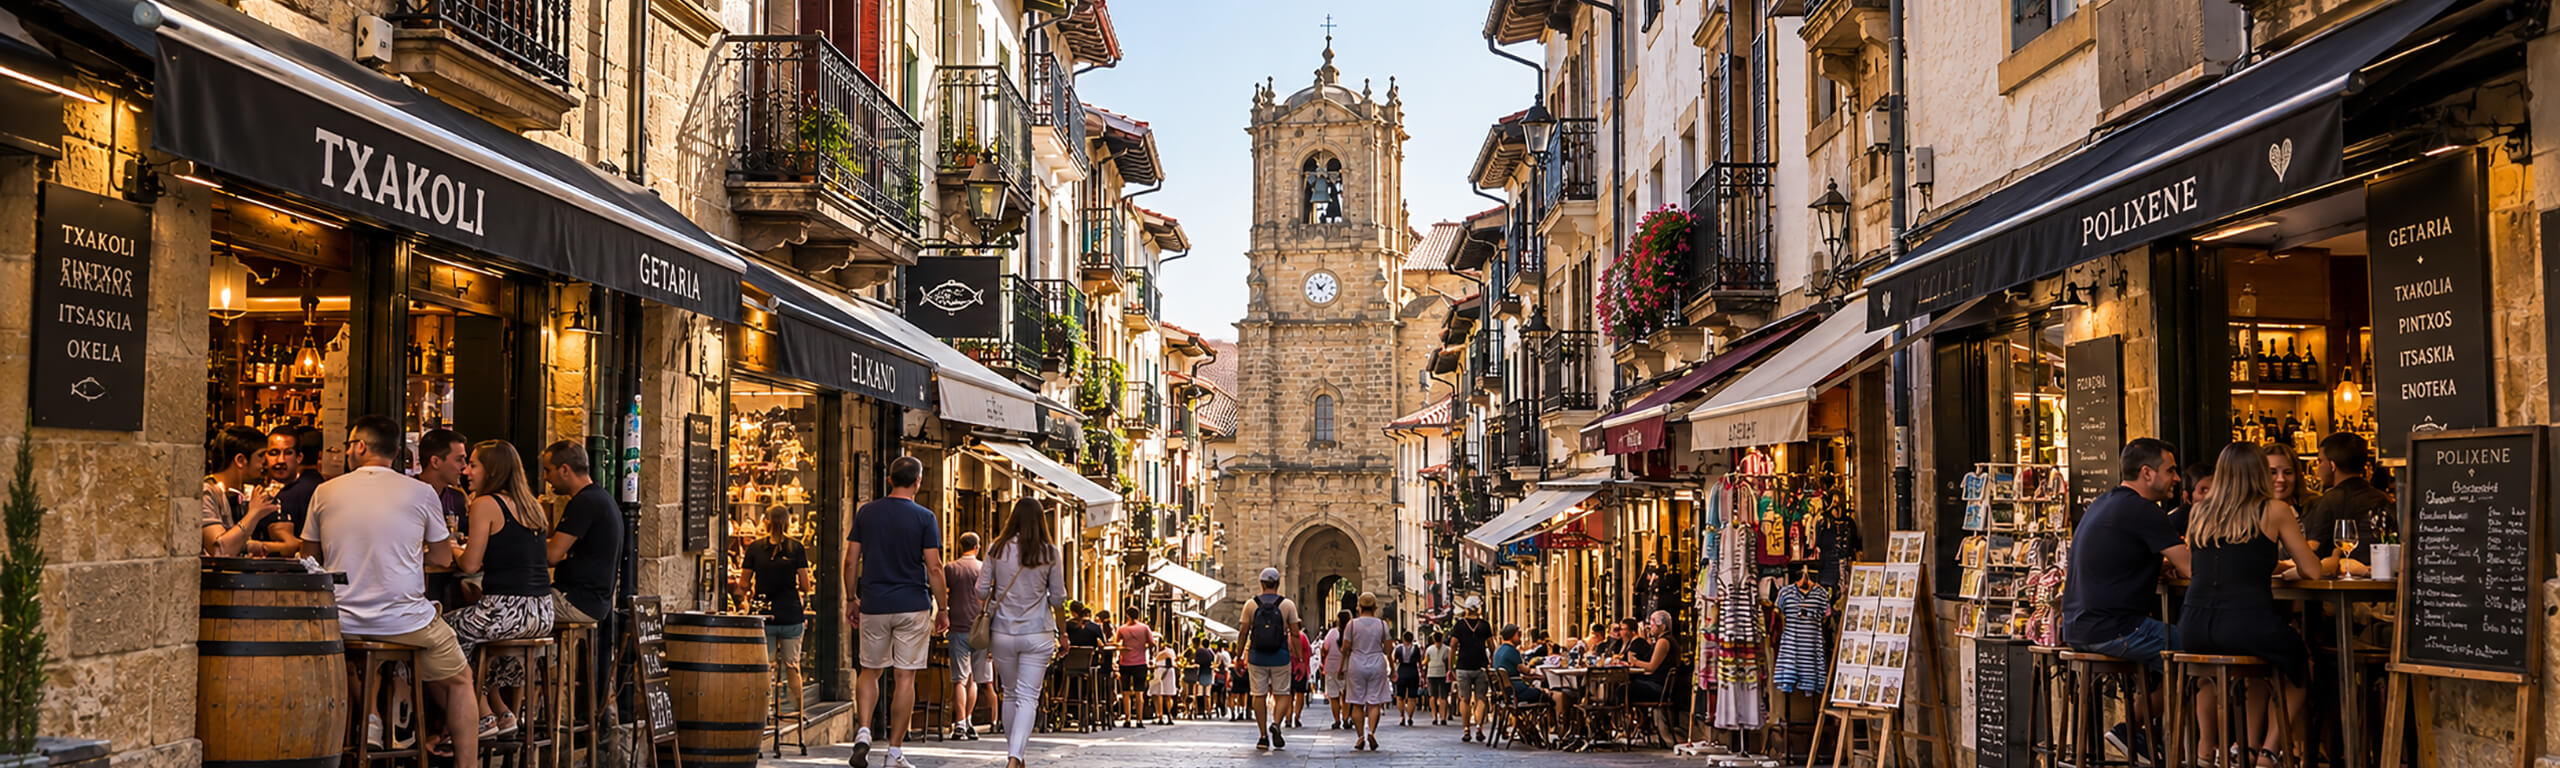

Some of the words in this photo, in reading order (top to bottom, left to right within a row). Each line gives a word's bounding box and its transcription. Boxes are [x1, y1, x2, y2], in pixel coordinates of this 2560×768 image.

[315, 127, 485, 237] TXAKOLI
[2082, 176, 2198, 247] POLIXENE
[61, 224, 136, 257] TXAKOLI
[2389, 216, 2452, 248] GETARIA
[640, 252, 702, 302] GETARIA
[2394, 277, 2454, 302] TXAKOLIA
[59, 303, 133, 331] ITSASKIA
[2399, 311, 2453, 334] PINTXOS
[67, 339, 122, 363] OKELA
[2400, 345, 2456, 367] ITSASKIA
[851, 351, 897, 394] ELKANO
[2402, 379, 2457, 400] ENOTEKA
[2437, 448, 2511, 465] POLIXENE
